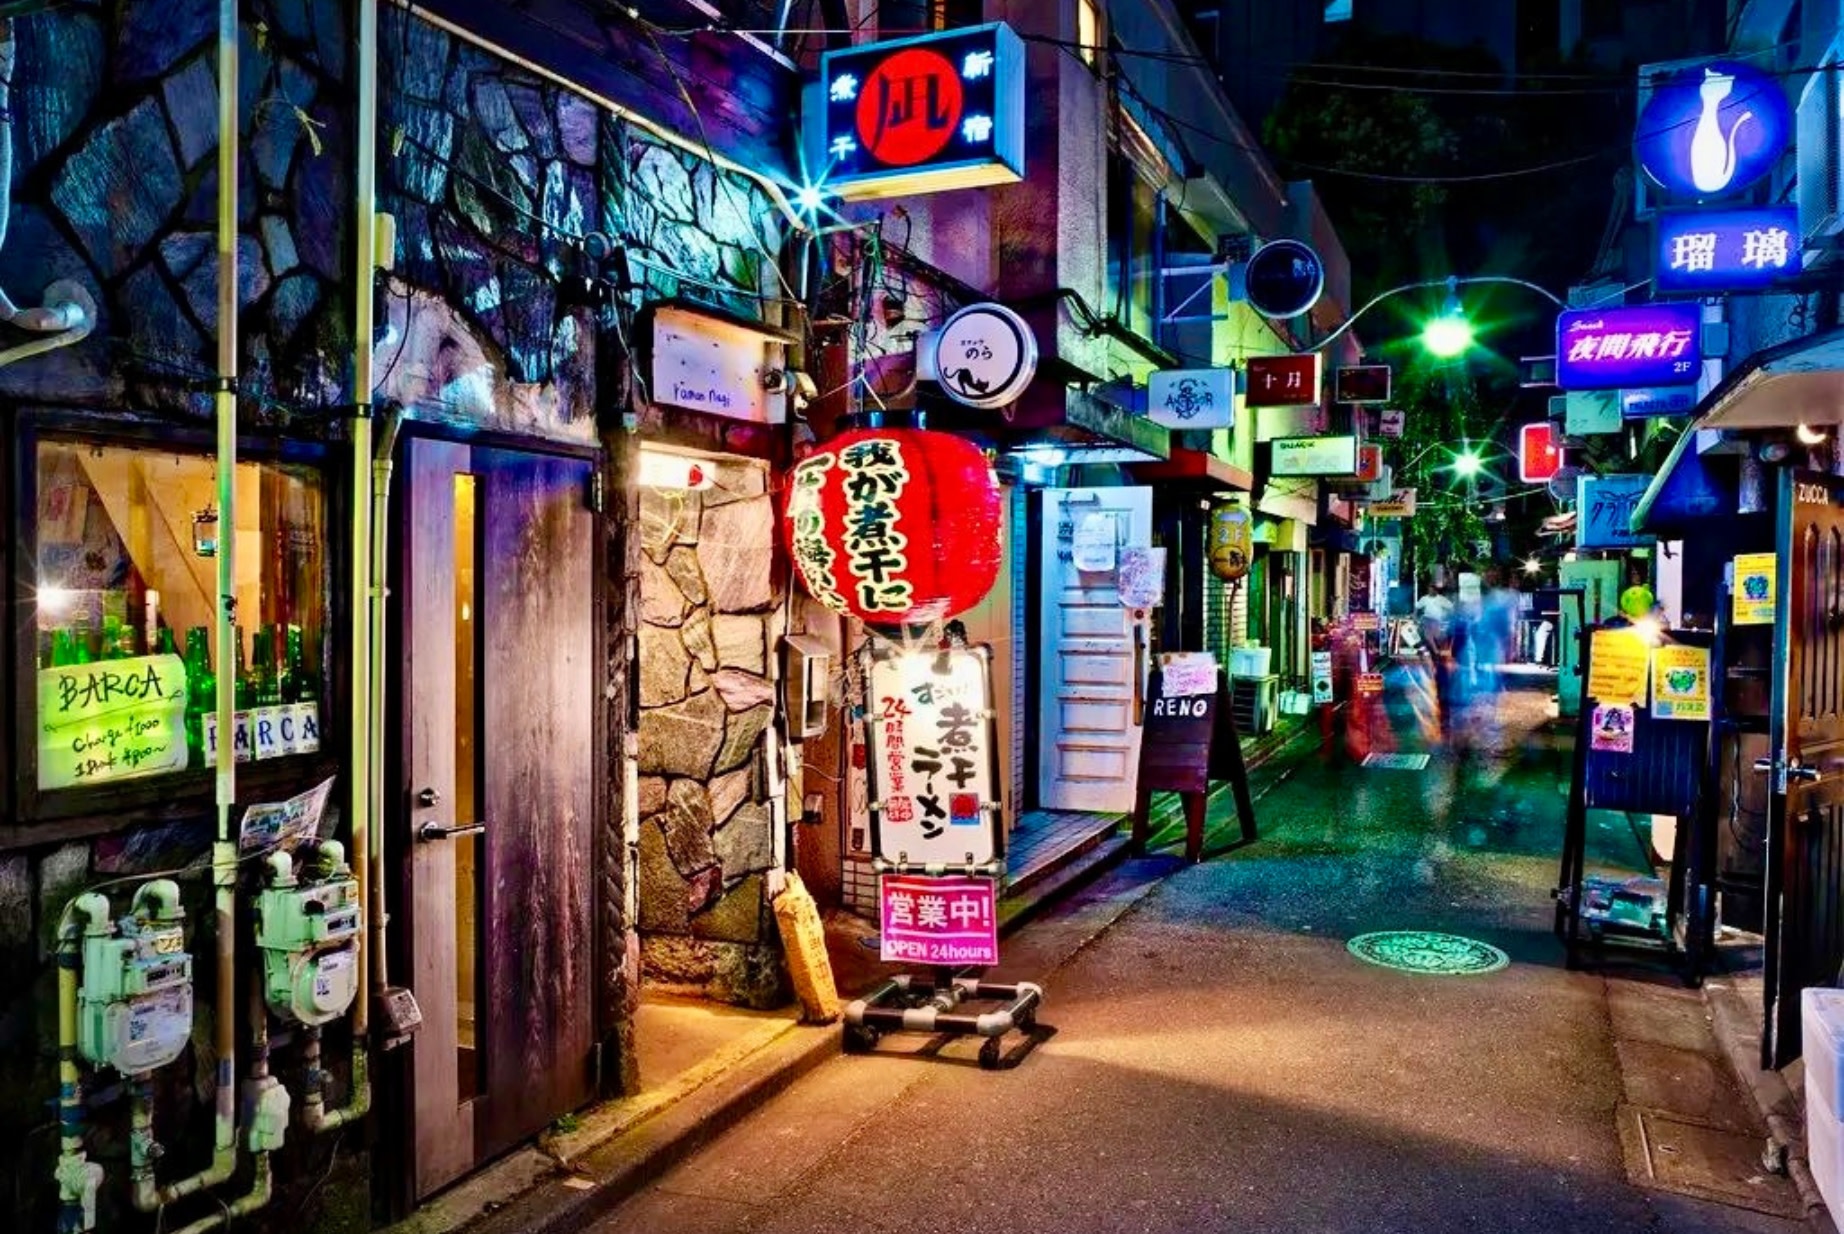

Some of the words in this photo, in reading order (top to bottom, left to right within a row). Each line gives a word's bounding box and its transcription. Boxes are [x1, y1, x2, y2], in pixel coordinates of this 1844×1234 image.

[963, 50, 994, 143] 新宿
[1670, 227, 1789, 273] 瑠璃
[965, 345, 993, 361] のら
[1672, 361, 1692, 373] 2F
[1262, 371, 1301, 390] 十月
[1798, 484, 1829, 505] ZUCCA
[843, 441, 907, 609] 我が煮干に
[58, 664, 163, 712] BARCA
[1153, 698, 1208, 718] RENO
[936, 702, 978, 789] 煮干
[911, 746, 947, 839] ラーメン
[887, 891, 990, 928] 営業中!
[885, 940, 928, 957] OPEN
